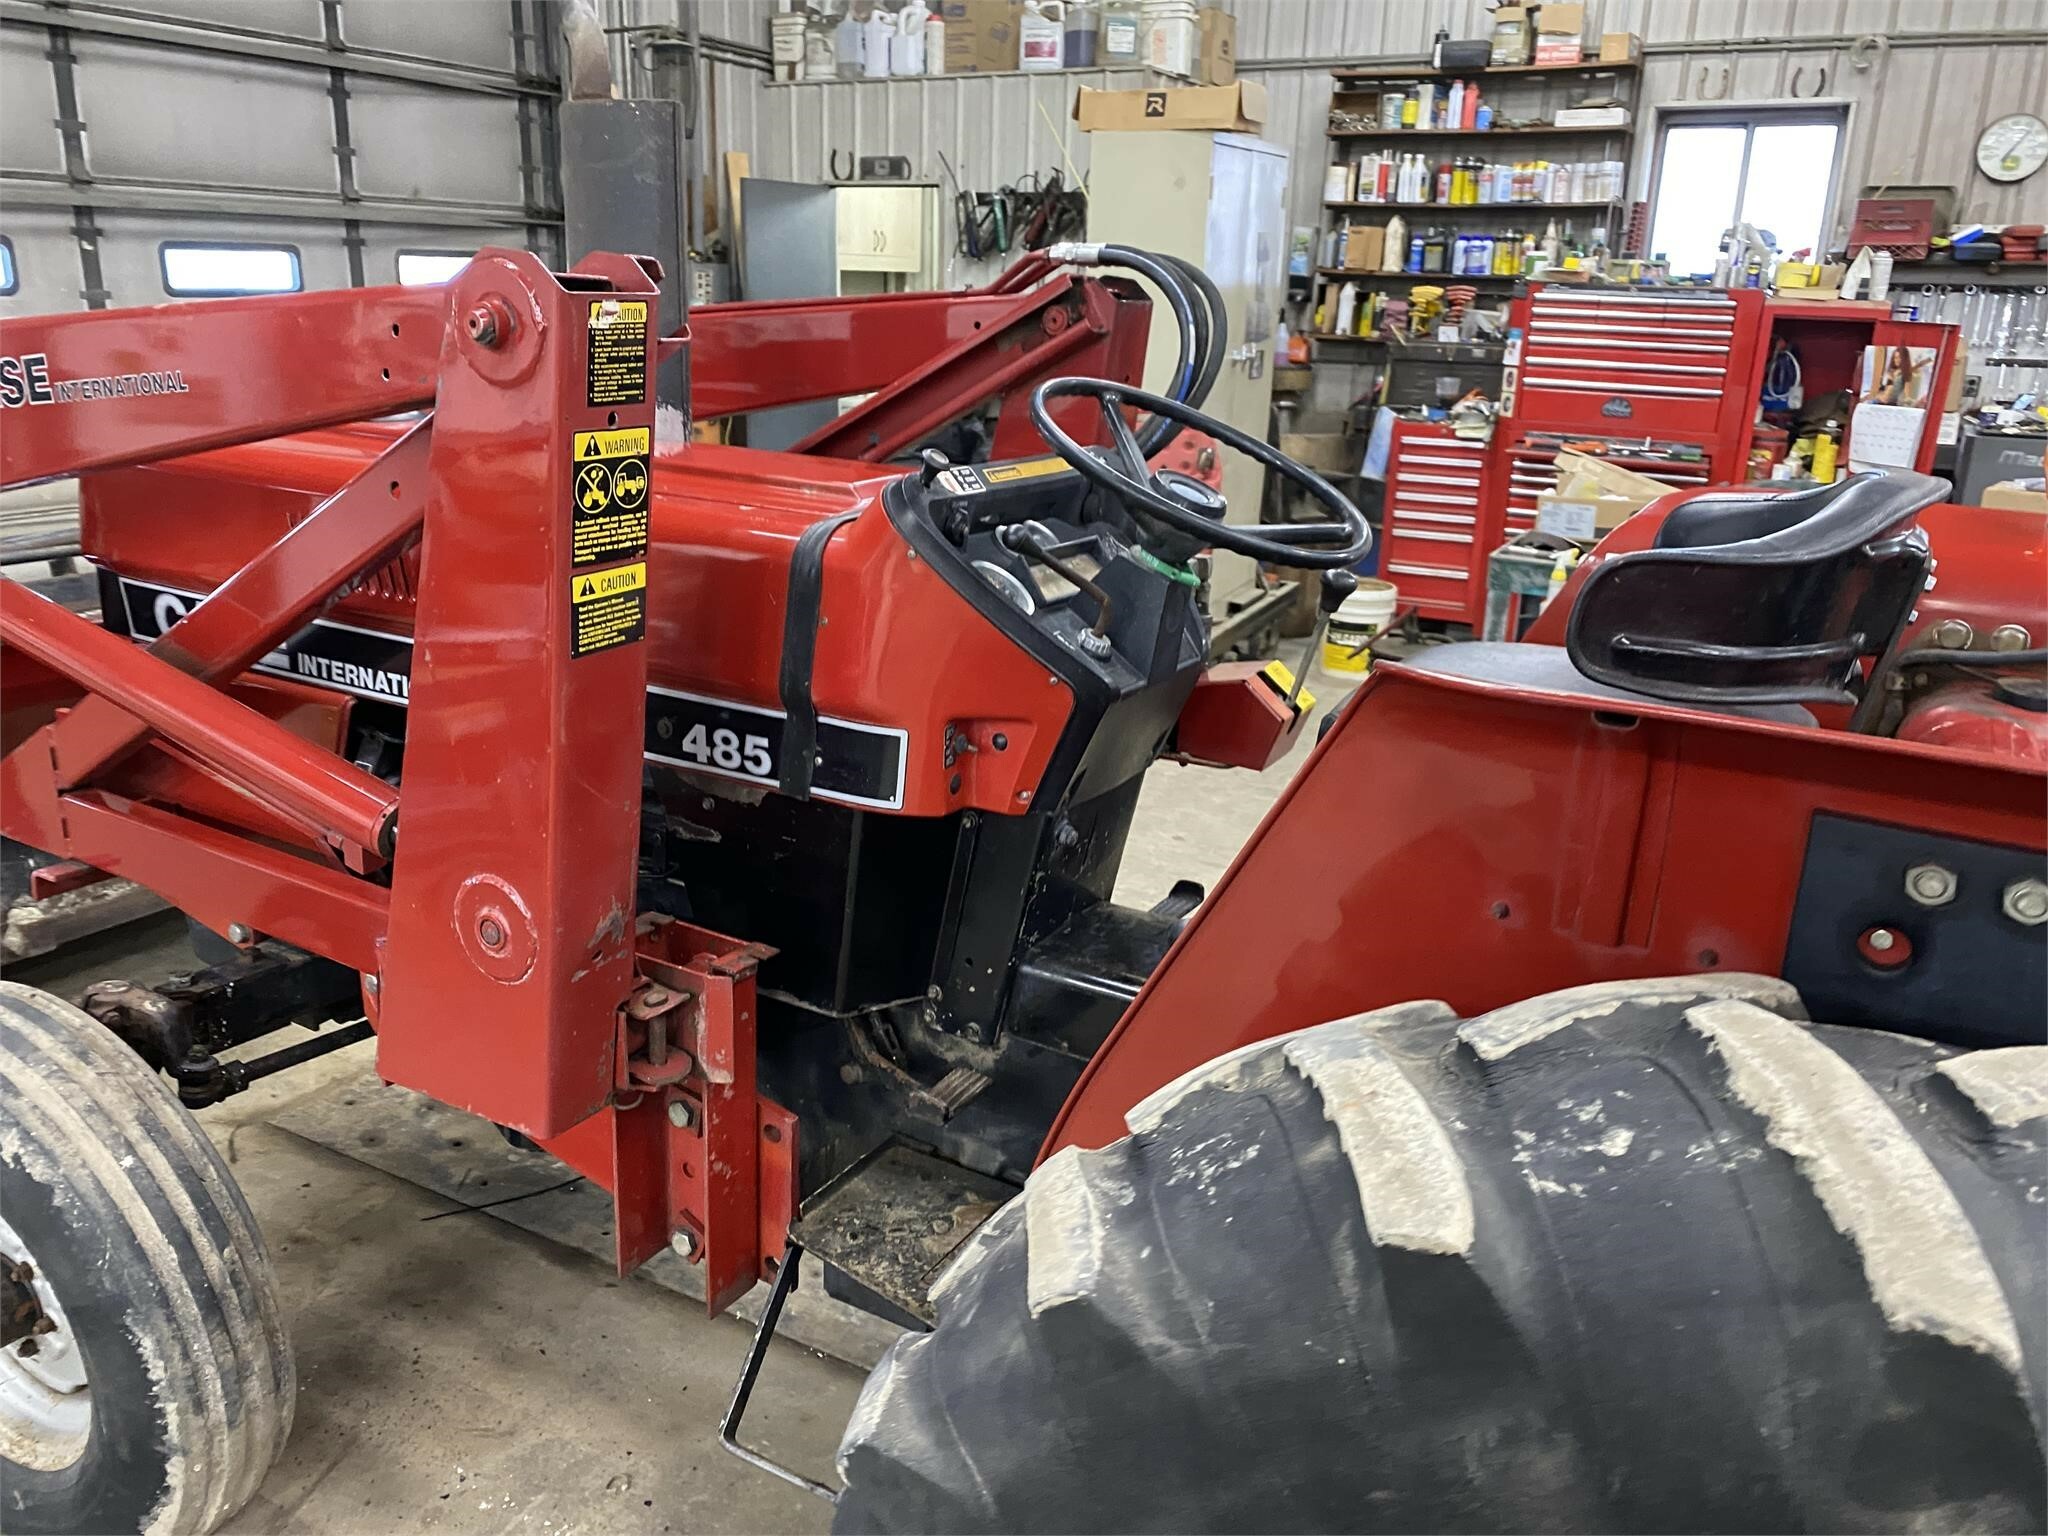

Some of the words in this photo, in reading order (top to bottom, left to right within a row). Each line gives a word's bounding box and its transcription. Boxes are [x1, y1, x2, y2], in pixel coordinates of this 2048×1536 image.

[616, 308, 643, 321] UTION
[55, 370, 189, 403] INTERNATIONAL
[604, 437, 645, 455] WARNING
[600, 572, 637, 593] CAUTION
[297, 652, 410, 697] INTERNATI
[682, 723, 772, 776] 485
